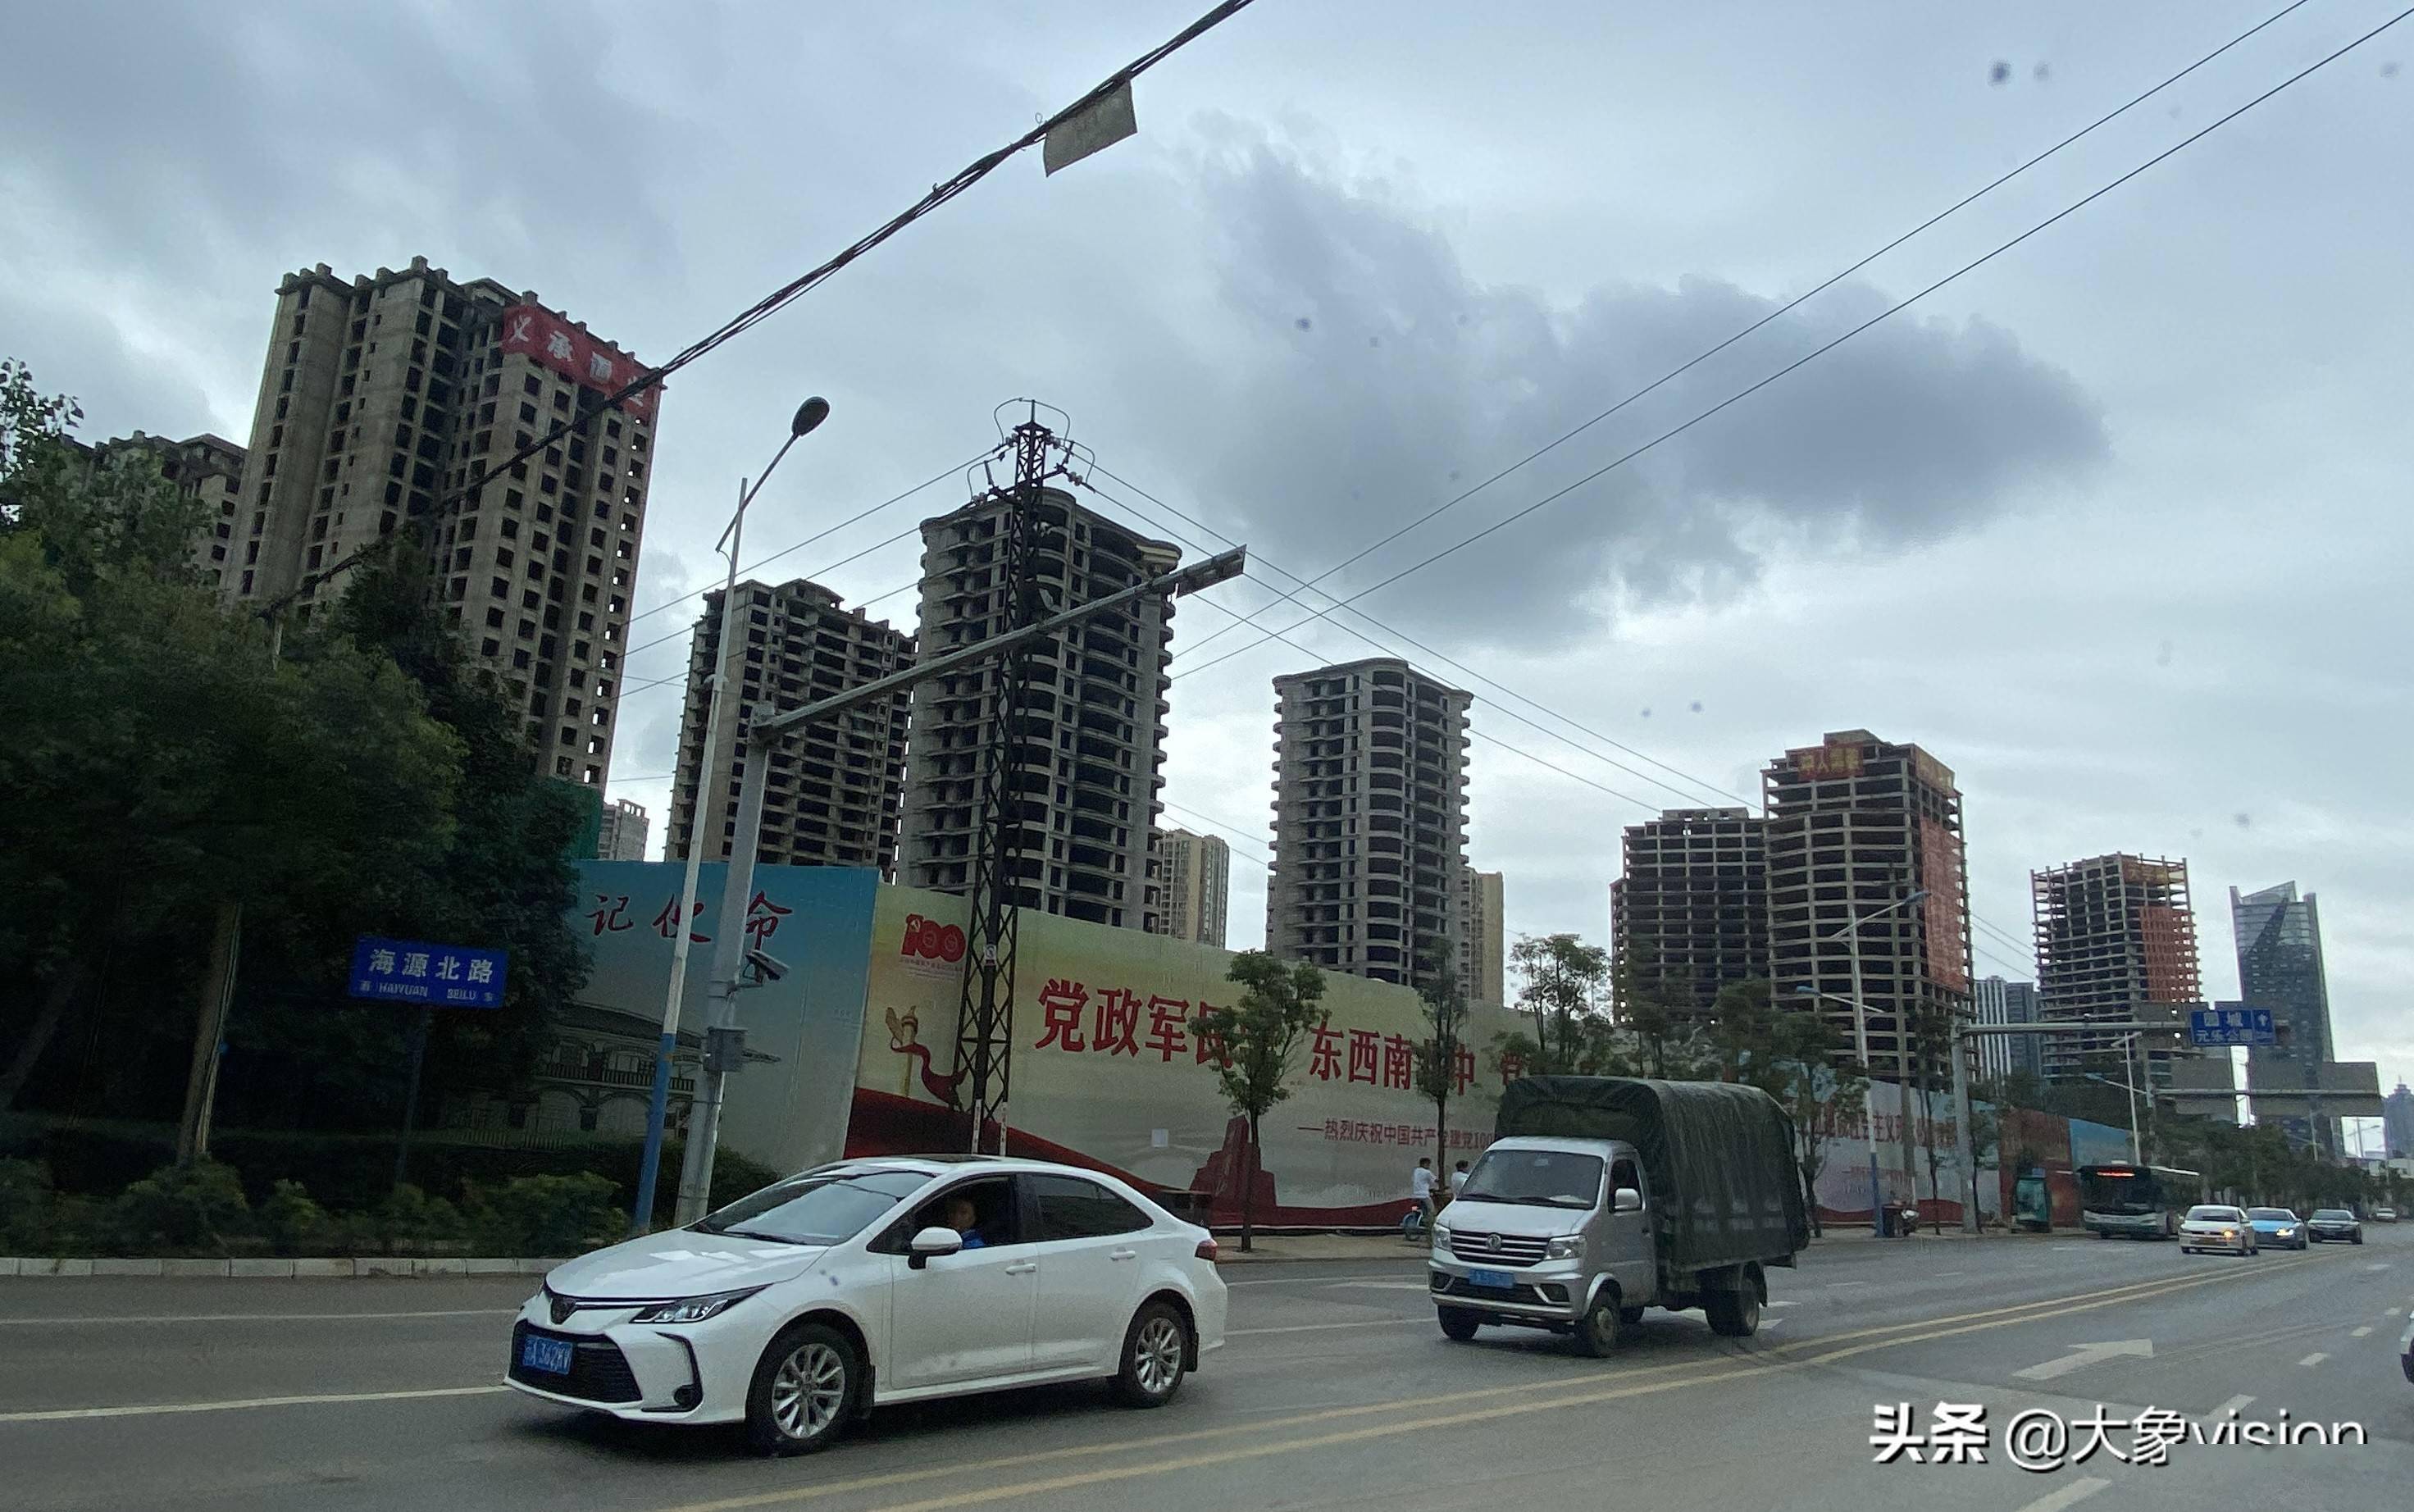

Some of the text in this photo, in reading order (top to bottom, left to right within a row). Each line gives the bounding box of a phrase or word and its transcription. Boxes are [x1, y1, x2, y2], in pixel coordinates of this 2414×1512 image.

[367, 948, 494, 984] 海源北路
[378, 981, 429, 998] HAIYUAN
[1035, 978, 1255, 1069] 党政军民
[1309, 1013, 1476, 1096] 东西南中
